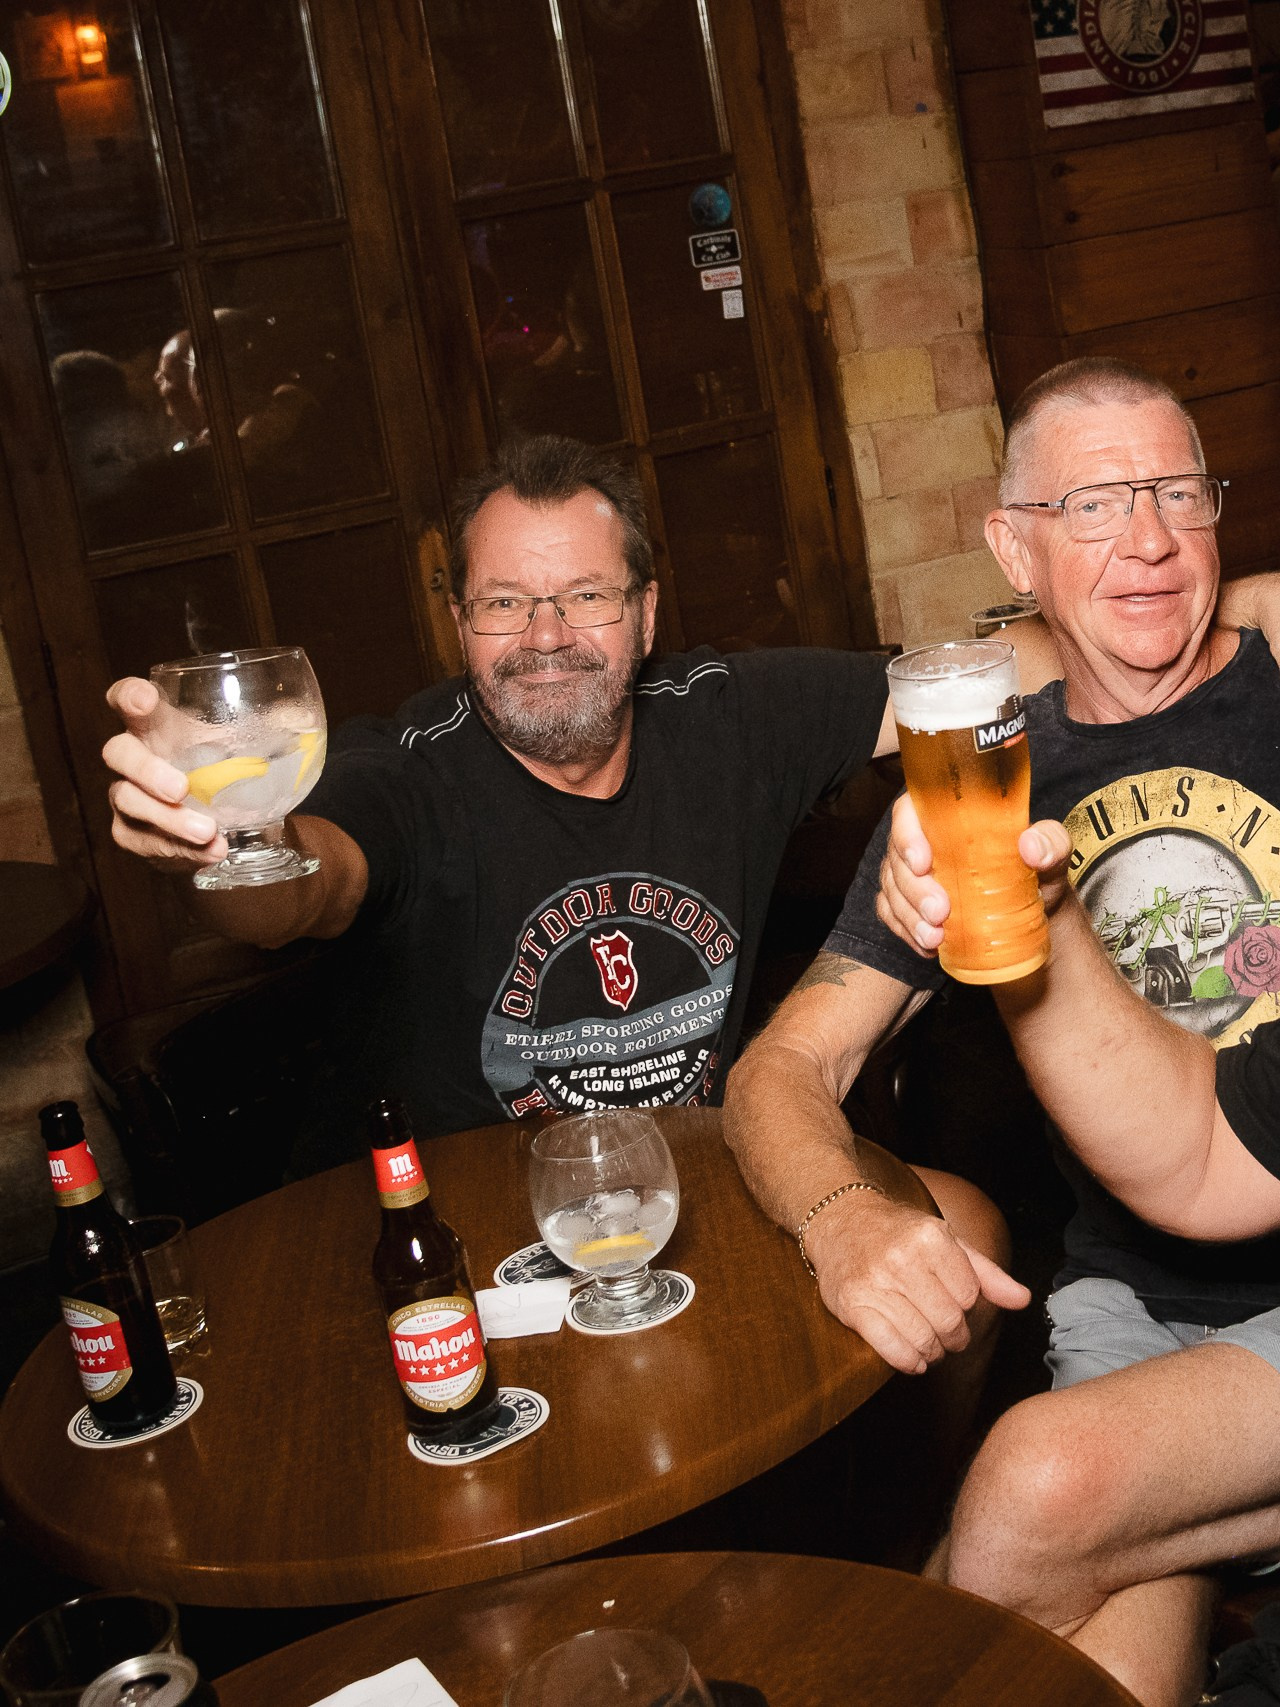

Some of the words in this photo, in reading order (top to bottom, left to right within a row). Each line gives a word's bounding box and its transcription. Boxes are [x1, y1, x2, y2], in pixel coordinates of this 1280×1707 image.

[1127, 66, 1169, 85] 1901
[501, 883, 616, 1018] OUTDOOR
[628, 881, 734, 965] GOODS
[503, 1028, 577, 1047] ETIREL
[580, 1009, 665, 1039] SPORTING
[670, 983, 734, 1018] GOODS
[520, 1041, 618, 1061] OUTDOOR
[623, 1007, 725, 1054] EQUIPMENT
[569, 1065, 607, 1080] EAST
[610, 1049, 687, 1078] SHORELINE
[583, 1079, 625, 1092] LONG
[629, 1066, 681, 1091] ISLAND
[415, 1301, 466, 1314] ESTRELLAS
[394, 1327, 476, 1362] Mahou
